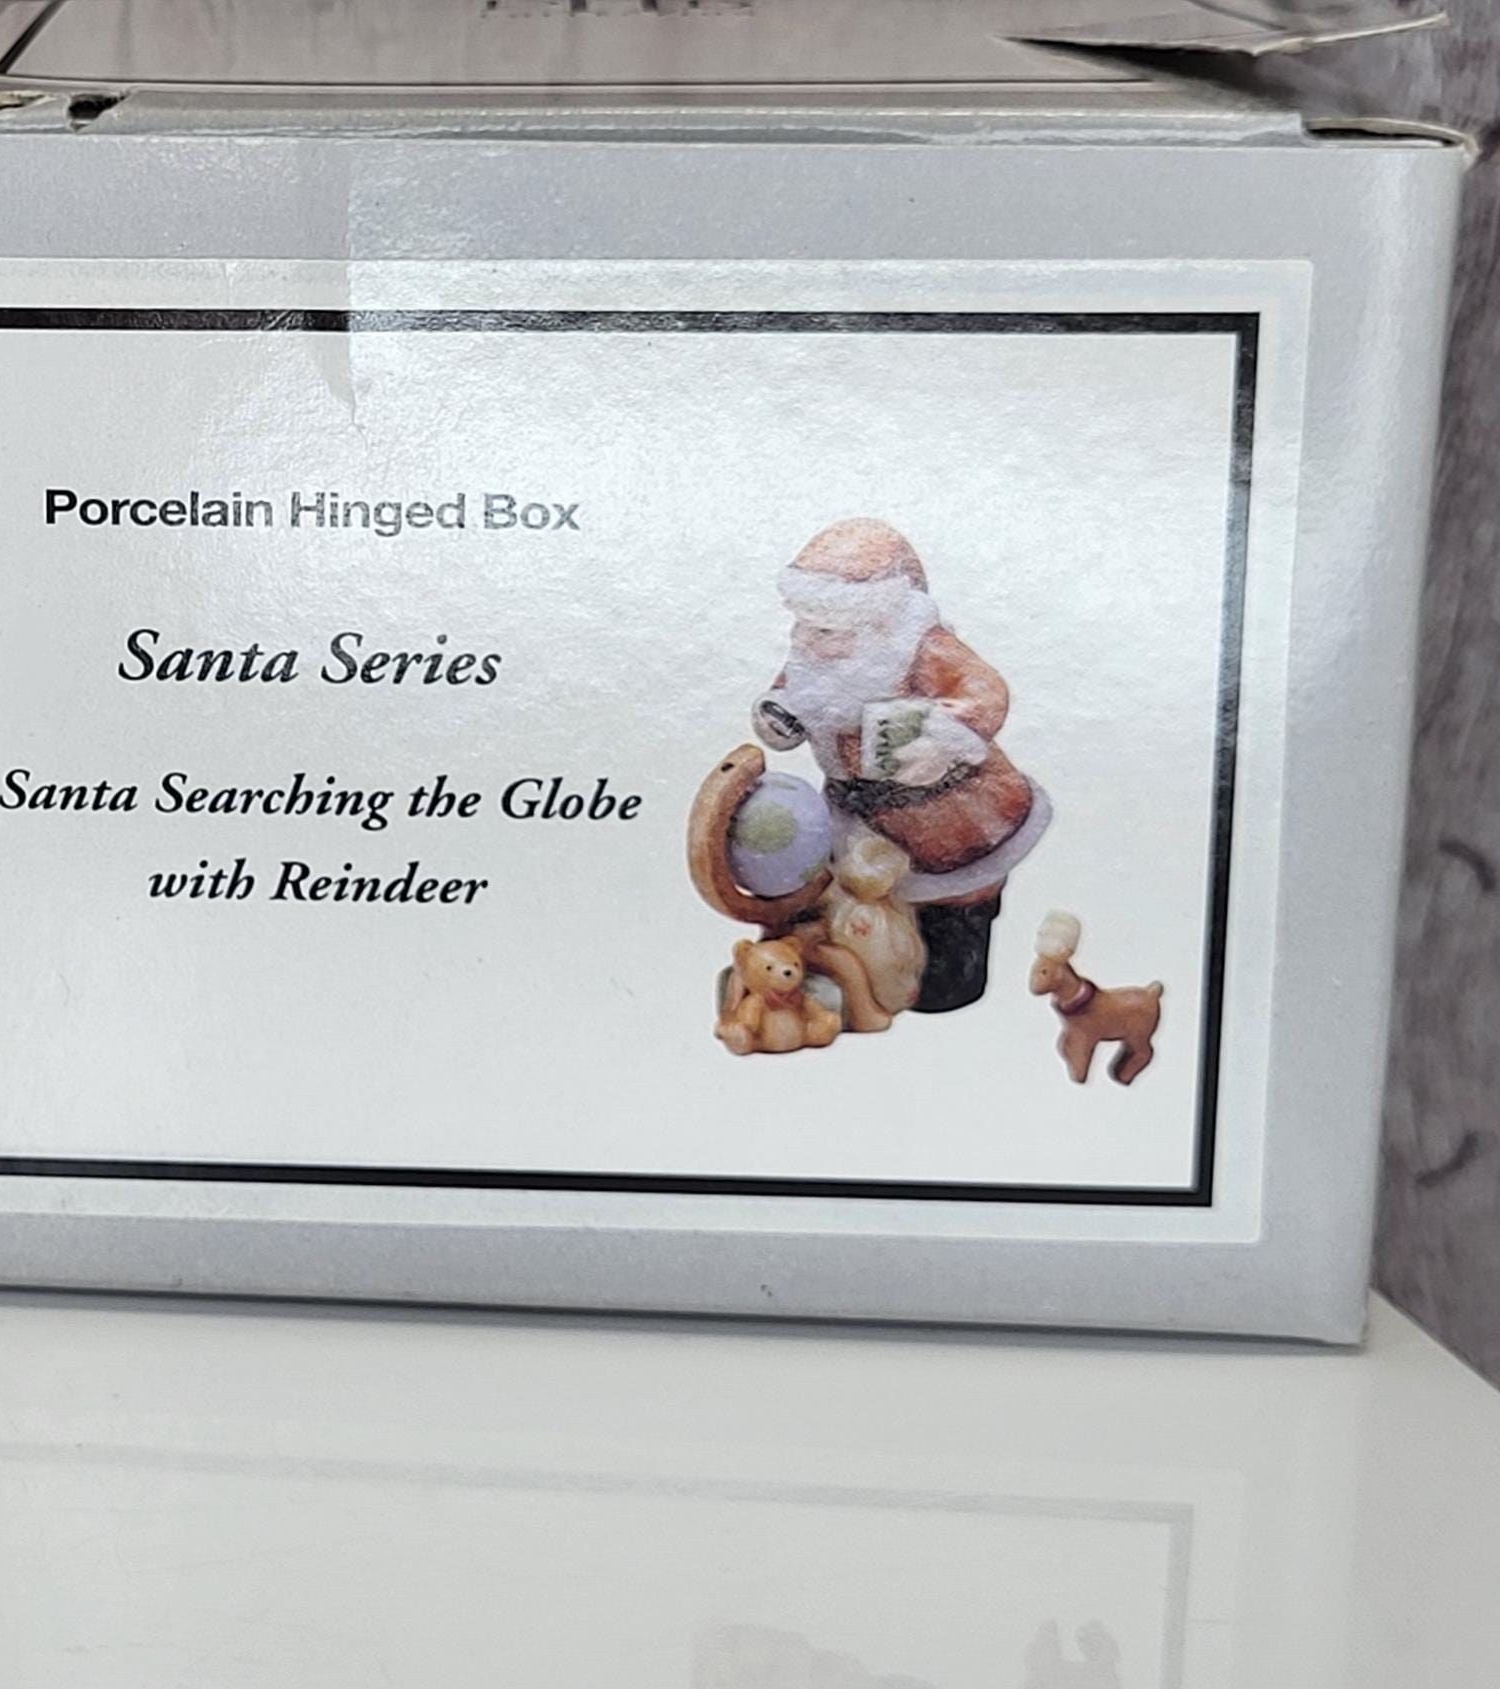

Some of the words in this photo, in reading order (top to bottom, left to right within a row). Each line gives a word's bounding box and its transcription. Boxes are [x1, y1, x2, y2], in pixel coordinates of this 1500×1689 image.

[45, 488, 274, 528] Porcelain
[290, 491, 466, 538] Hinged
[483, 493, 580, 531] Box
[118, 628, 299, 684] Santa
[320, 631, 503, 686] Series
[154, 771, 396, 831] Searching
[406, 773, 483, 819] the
[500, 776, 643, 821] Globe
[147, 857, 256, 901] with
[269, 860, 489, 905] Reindeer
